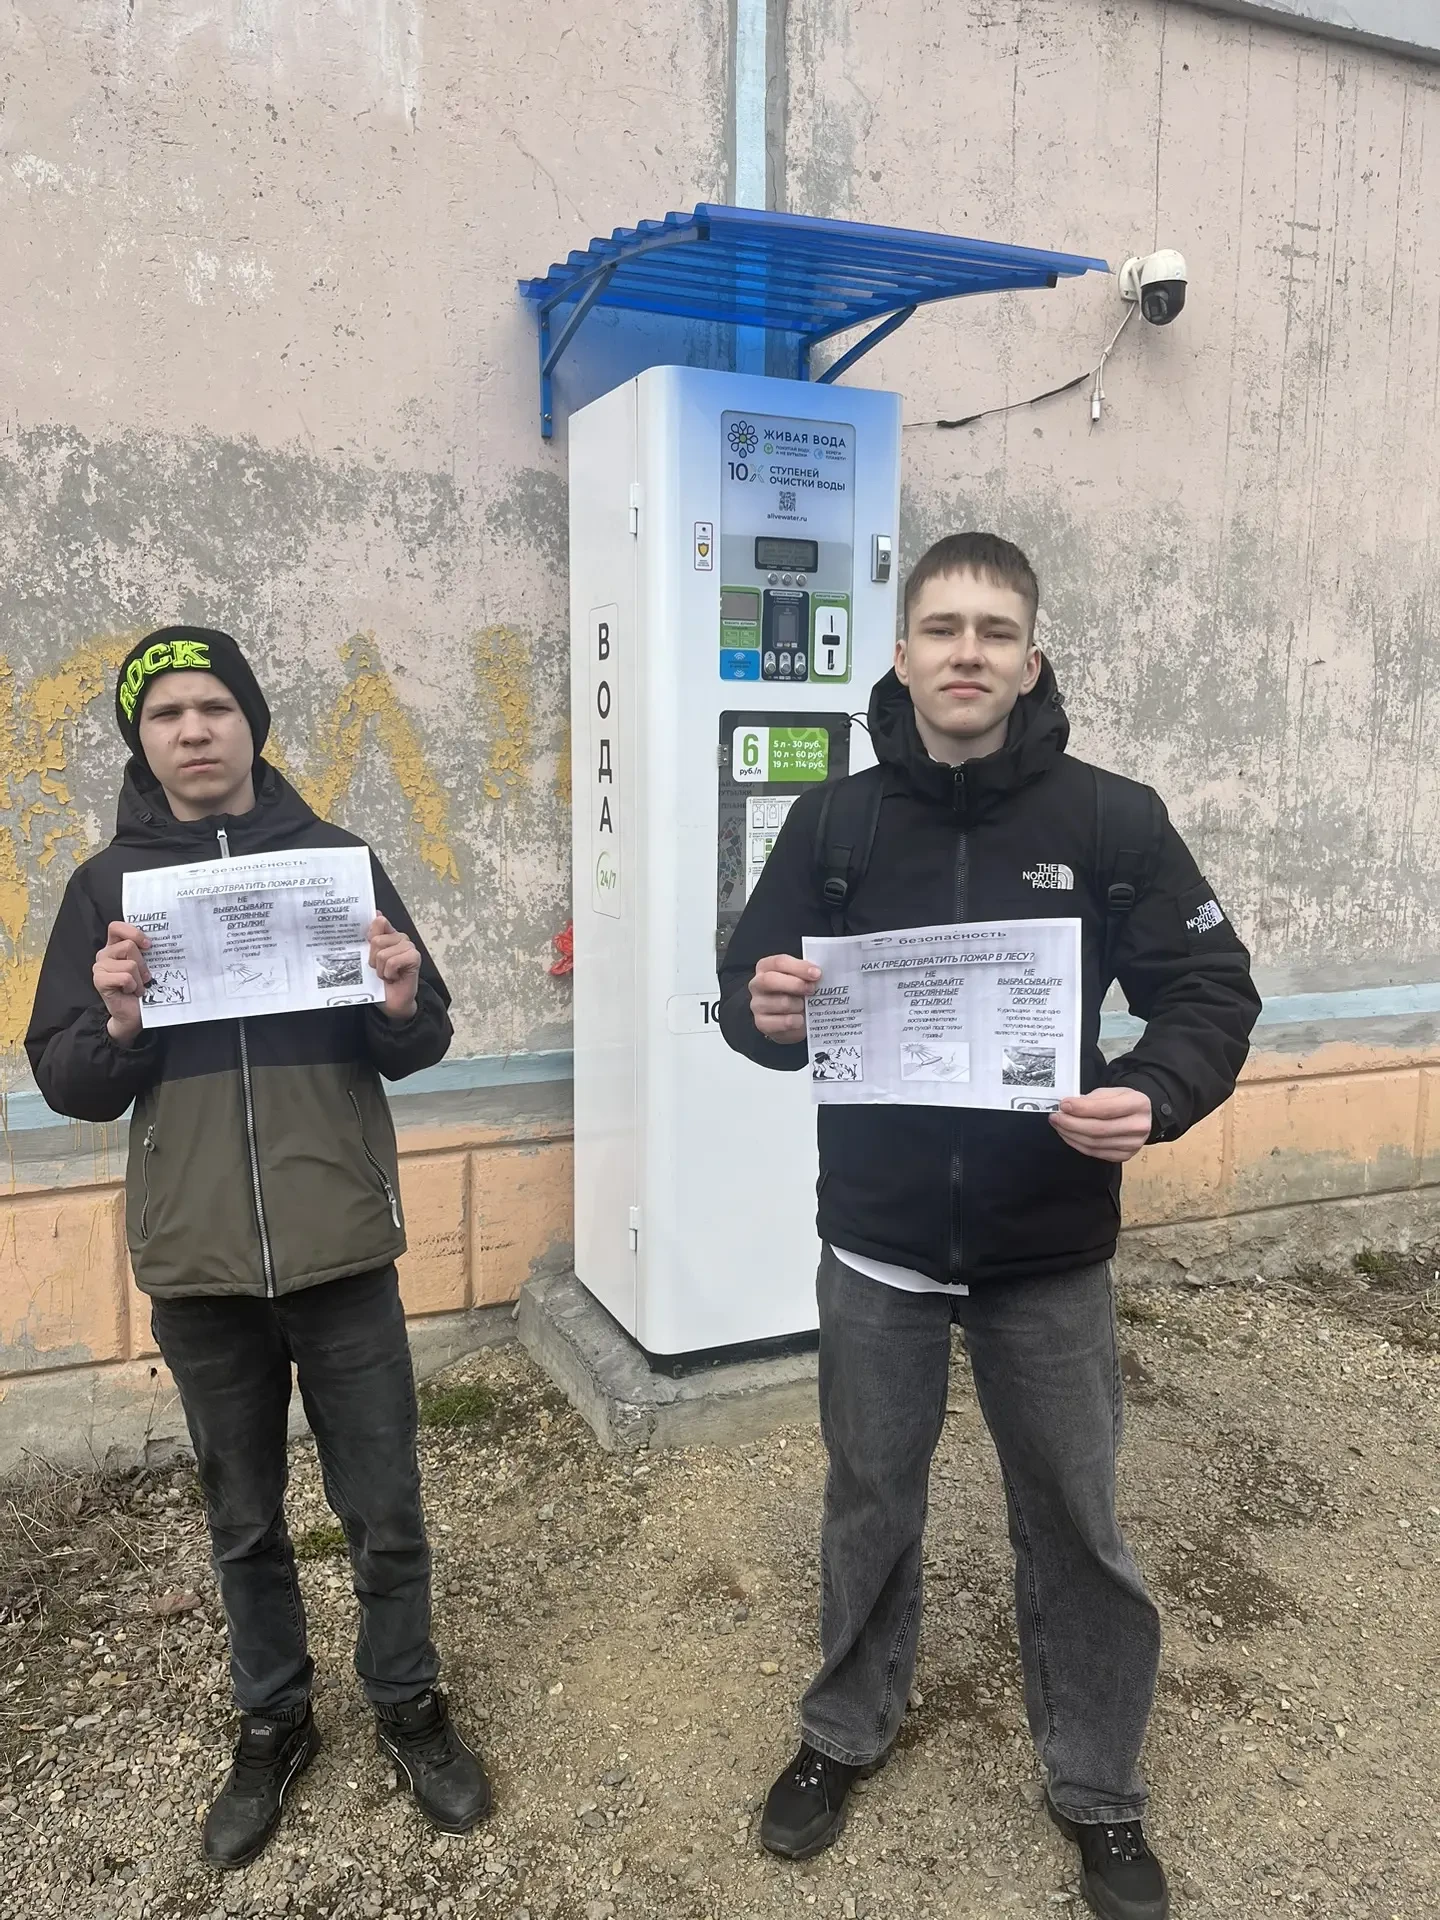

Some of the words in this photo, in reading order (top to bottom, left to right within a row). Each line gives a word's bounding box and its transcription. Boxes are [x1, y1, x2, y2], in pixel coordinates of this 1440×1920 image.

[764, 429, 808, 444] ЖИВАЯ
[813, 435, 846, 448] ВОДА
[769, 465, 819, 478] СТУПЕНЕЙ
[769, 476, 815, 488] ОЧИСТКИ
[817, 481, 845, 491] ВОДЫ
[767, 513, 808, 522] alivewater.ru
[119, 640, 211, 724] ROCK
[743, 733, 759, 766] 6
[773, 740, 779, 748] 5
[792, 740, 802, 748] 30
[804, 740, 821, 749] руб.
[773, 750, 782, 758] 10
[796, 750, 807, 758] 60
[808, 750, 824, 759] руб.
[773, 760, 781, 768] 19
[795, 760, 807, 768] 114
[808, 760, 825, 769] руб.
[739, 767, 761, 775] руб./л
[211, 861, 307, 874] безопасность
[1036, 863, 1058, 873] THE
[600, 869, 616, 889] 24/7
[1022, 871, 1057, 880] NORTH
[176, 888, 195, 897] КАК
[196, 881, 266, 896] ПРЕДОТВРАТИТЬ
[267, 879, 298, 888] ПОЖАР
[307, 877, 333, 885] ЛЕСУ?
[1032, 880, 1057, 889] FACE
[325, 889, 335, 897] НЕ
[237, 895, 248, 903] НЕ
[303, 896, 359, 907] ВЫБРАСЫВАЙТЕ
[213, 902, 274, 914] ВЫБРАСЫВАЙТЕ
[1196, 902, 1211, 915] THE
[126, 911, 167, 922] ТУШИТЕ
[220, 911, 271, 922] СТЕКЛЯННЫЕ
[1185, 911, 1212, 930] NORTH
[135, 922, 169, 932] ОСТРЫ!
[227, 919, 266, 929] БУТЫЛКИ!
[1197, 916, 1217, 934] FACE
[898, 931, 1007, 945] безопасность
[860, 962, 880, 971] КАК
[881, 955, 958, 968] ПРЕДОТВРАТИТЬ
[960, 953, 994, 963] ПОЖАР
[996, 953, 1002, 961] В
[1004, 952, 1035, 961] ЛЕСУ?
[924, 970, 937, 978] НЕ
[1023, 968, 1036, 976] НЕ
[897, 977, 965, 989] ВЫБРАСЫВАЙТЕ
[997, 977, 1063, 986] ВЫБРАСЫВАЙТЕ
[810, 985, 849, 996] УШИТЕ
[904, 988, 960, 998] СТЕКЛЯННЫЕ
[1008, 987, 1051, 995] ТЛЕЮЩИЕ
[807, 996, 850, 1007] КОСТРЫ!
[910, 998, 953, 1006] БУТЫЛКИ!
[1012, 997, 1047, 1005] ОКУРКИ!
